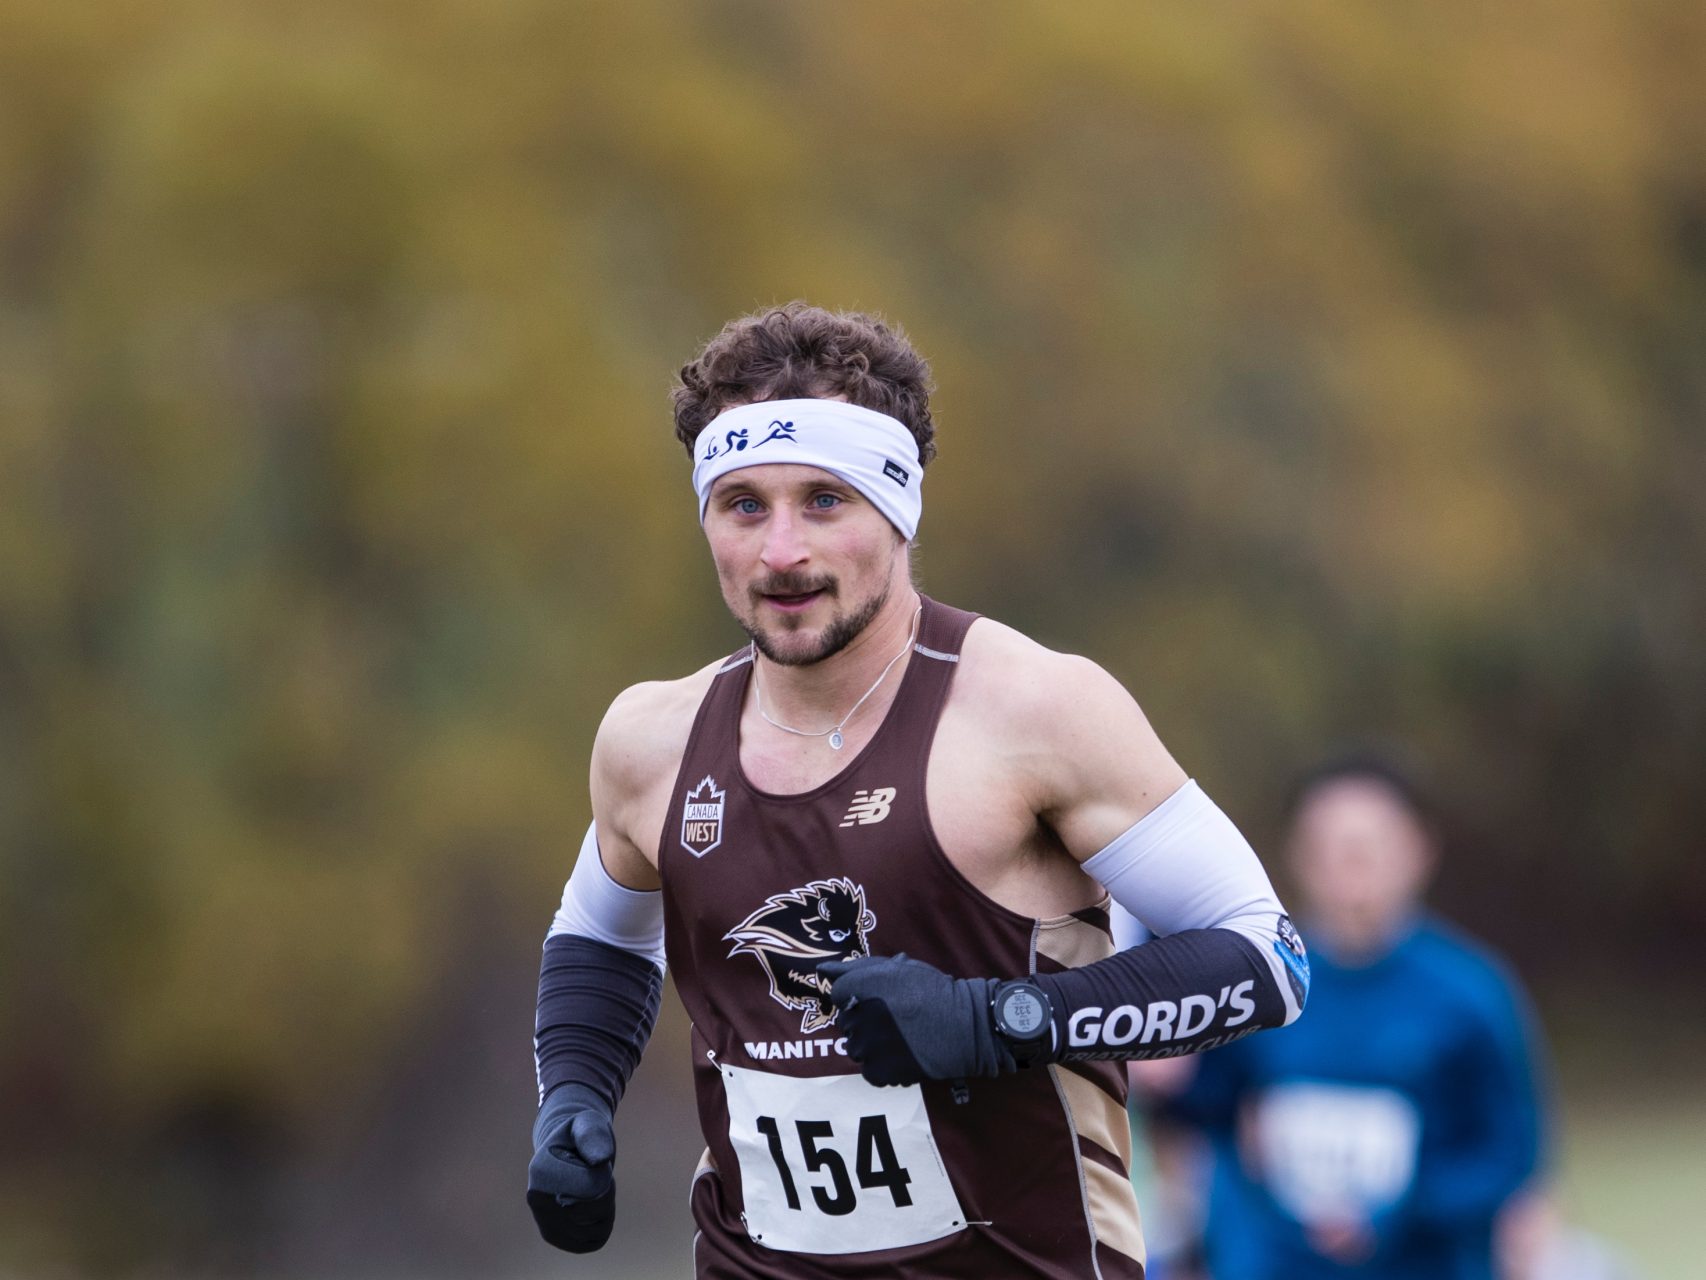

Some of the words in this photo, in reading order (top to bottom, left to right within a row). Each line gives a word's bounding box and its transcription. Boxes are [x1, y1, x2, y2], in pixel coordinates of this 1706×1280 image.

[686, 822, 718, 843] WEST
[687, 804, 719, 819] CANADA
[1068, 980, 1255, 1048] GORD'S
[756, 1114, 913, 1216] 154
